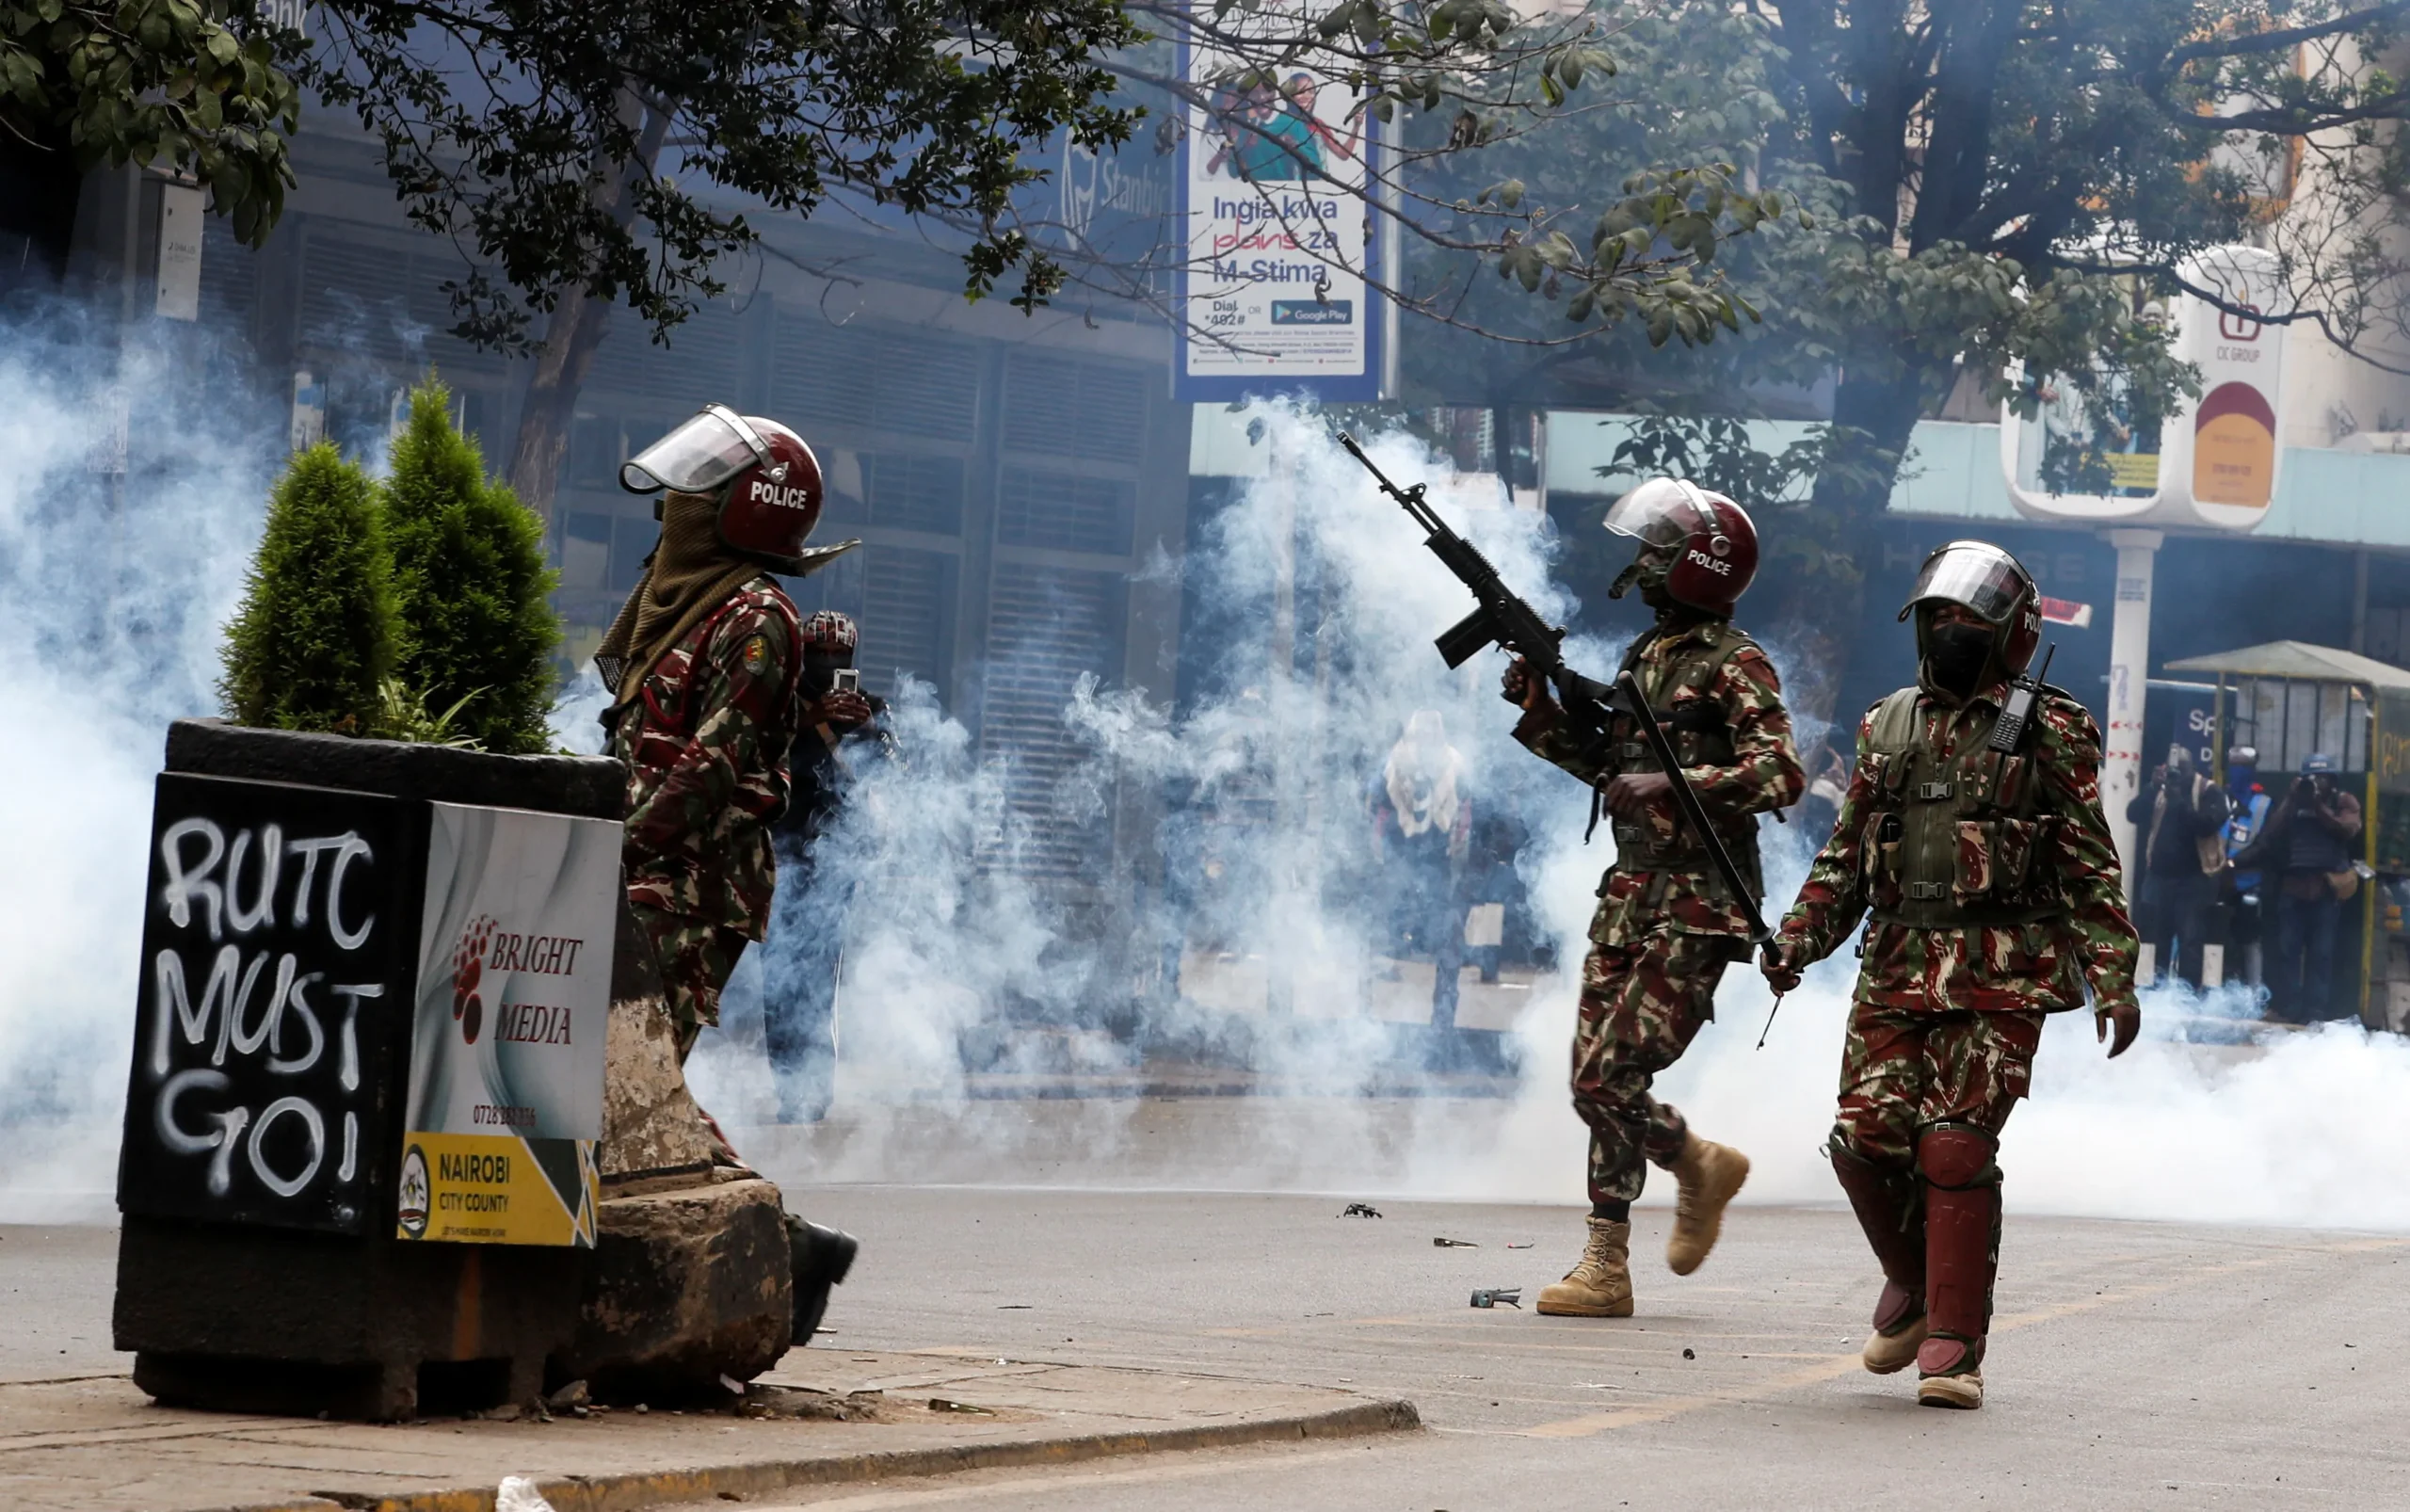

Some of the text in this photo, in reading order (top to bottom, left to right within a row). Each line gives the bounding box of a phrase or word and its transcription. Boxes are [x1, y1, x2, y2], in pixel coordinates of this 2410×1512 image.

[1213, 195, 1338, 225] Ingia kwa
[1213, 215, 1338, 263] plans za
[1213, 259, 1326, 283] M-Stima
[1213, 299, 1238, 312] Dial
[1247, 305, 1261, 314] OR
[1294, 309, 1347, 322] Google Play
[750, 480, 808, 510] POLICE
[1687, 549, 1732, 576] POLICE
[490, 932, 585, 976] BRIGHT
[153, 943, 385, 1092] MUST
[494, 1003, 572, 1045] MEDIA
[440, 1152, 510, 1184] NAIROBI
[439, 1192, 509, 1214] CITY COUNTY
